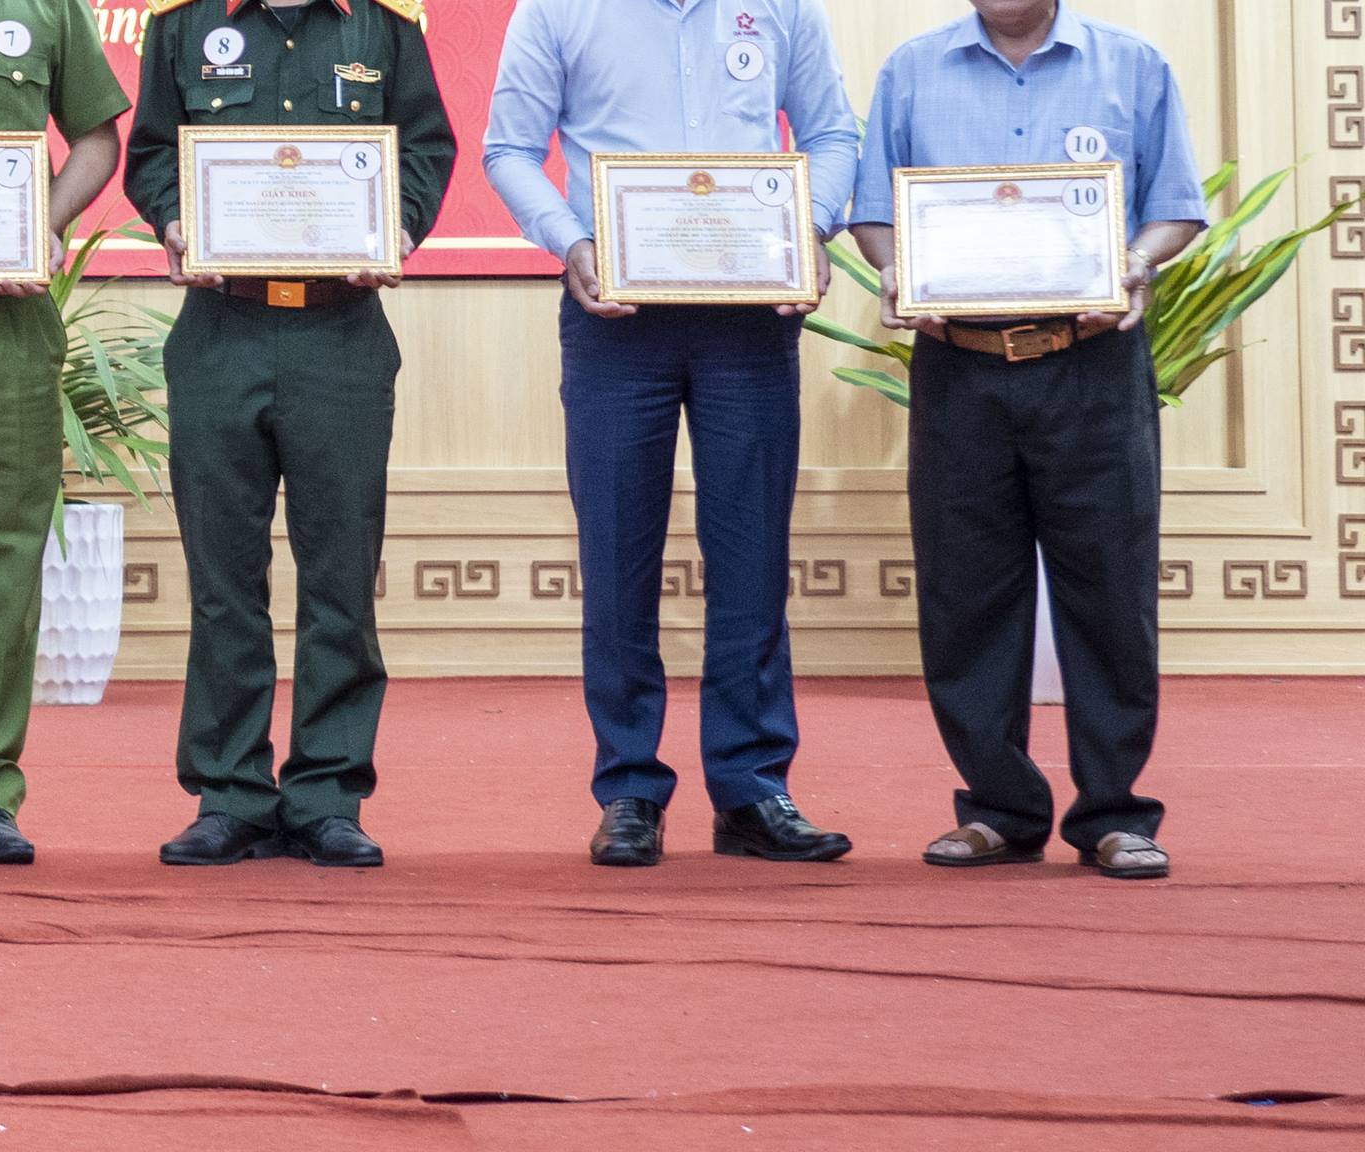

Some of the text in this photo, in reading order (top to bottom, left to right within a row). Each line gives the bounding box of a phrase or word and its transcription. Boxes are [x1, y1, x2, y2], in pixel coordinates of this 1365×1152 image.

[4, 30, 15, 47] 7
[218, 37, 230, 55] 8
[738, 52, 750, 70] 9
[1074, 135, 1098, 154] 10
[6, 158, 18, 177] 7
[355, 151, 367, 169] 8
[766, 176, 779, 195] 9
[1072, 186, 1097, 205] 10
